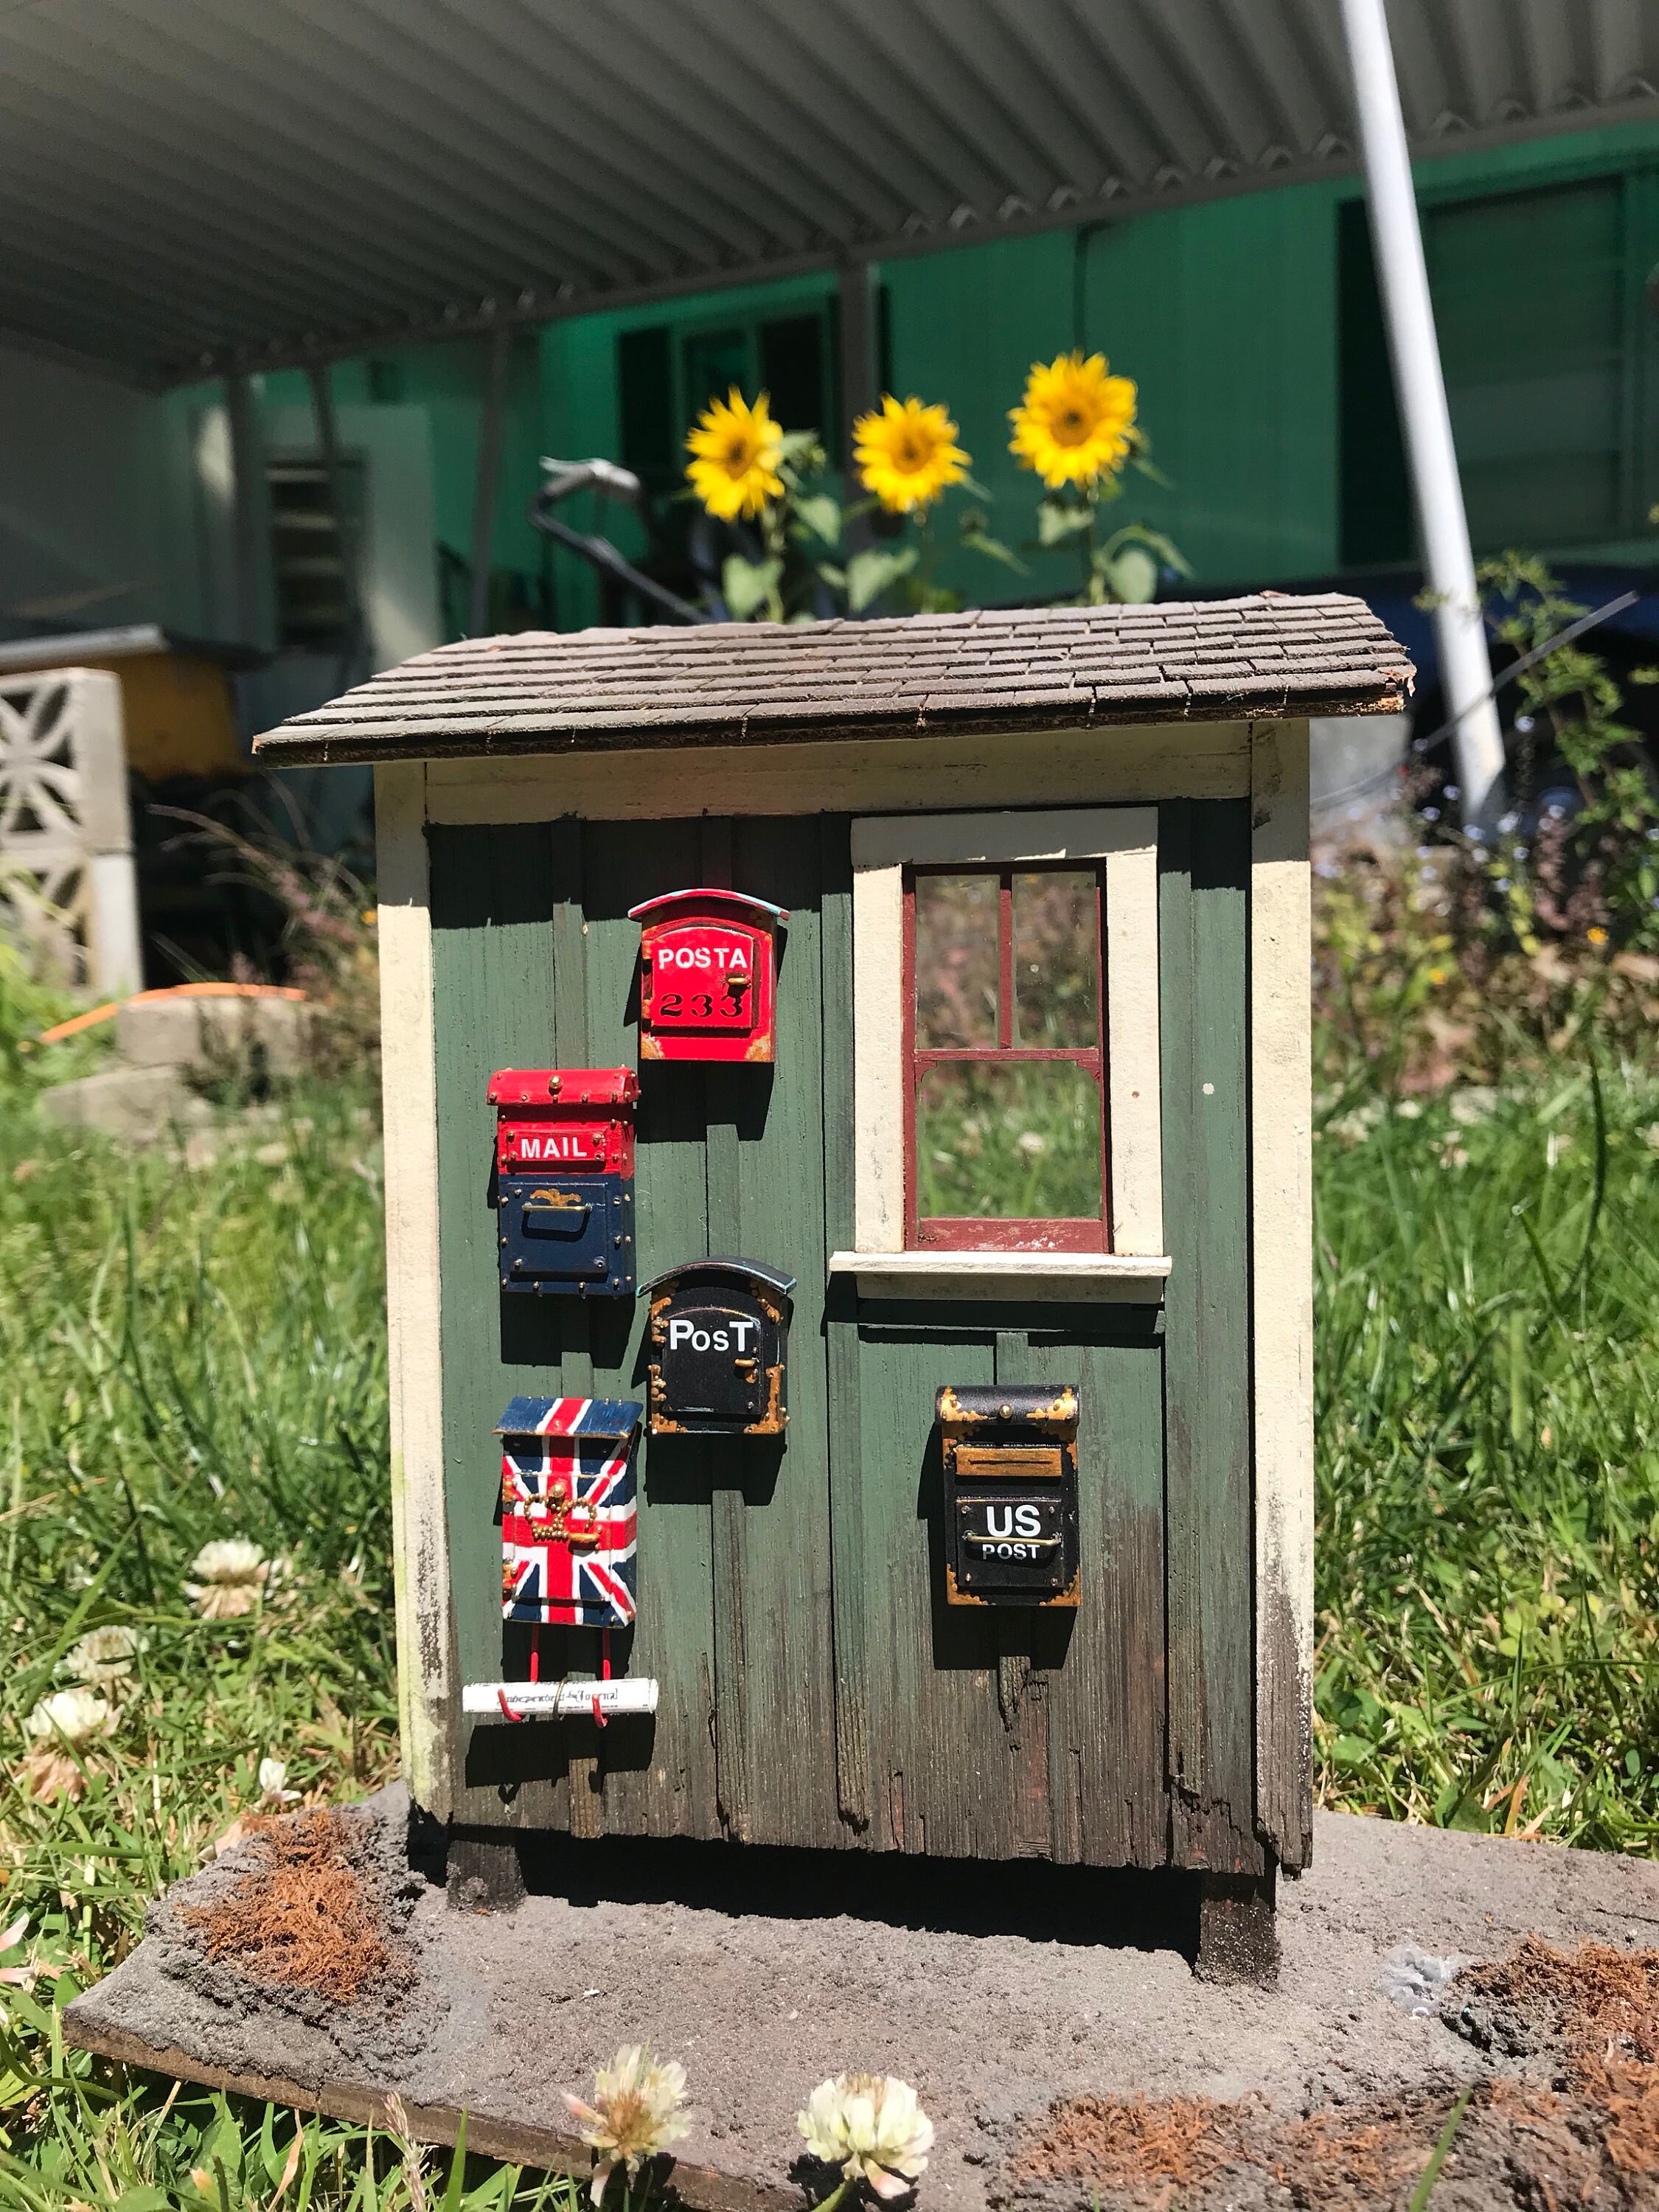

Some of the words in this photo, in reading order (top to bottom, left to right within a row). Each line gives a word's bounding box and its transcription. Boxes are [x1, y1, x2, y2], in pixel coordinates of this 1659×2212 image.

[658, 947, 748, 970] POSTA
[660, 993, 743, 1018] 233
[521, 1136, 588, 1158] MAIL
[986, 1504, 1041, 1537] US
[982, 1544, 1040, 1560] POST
